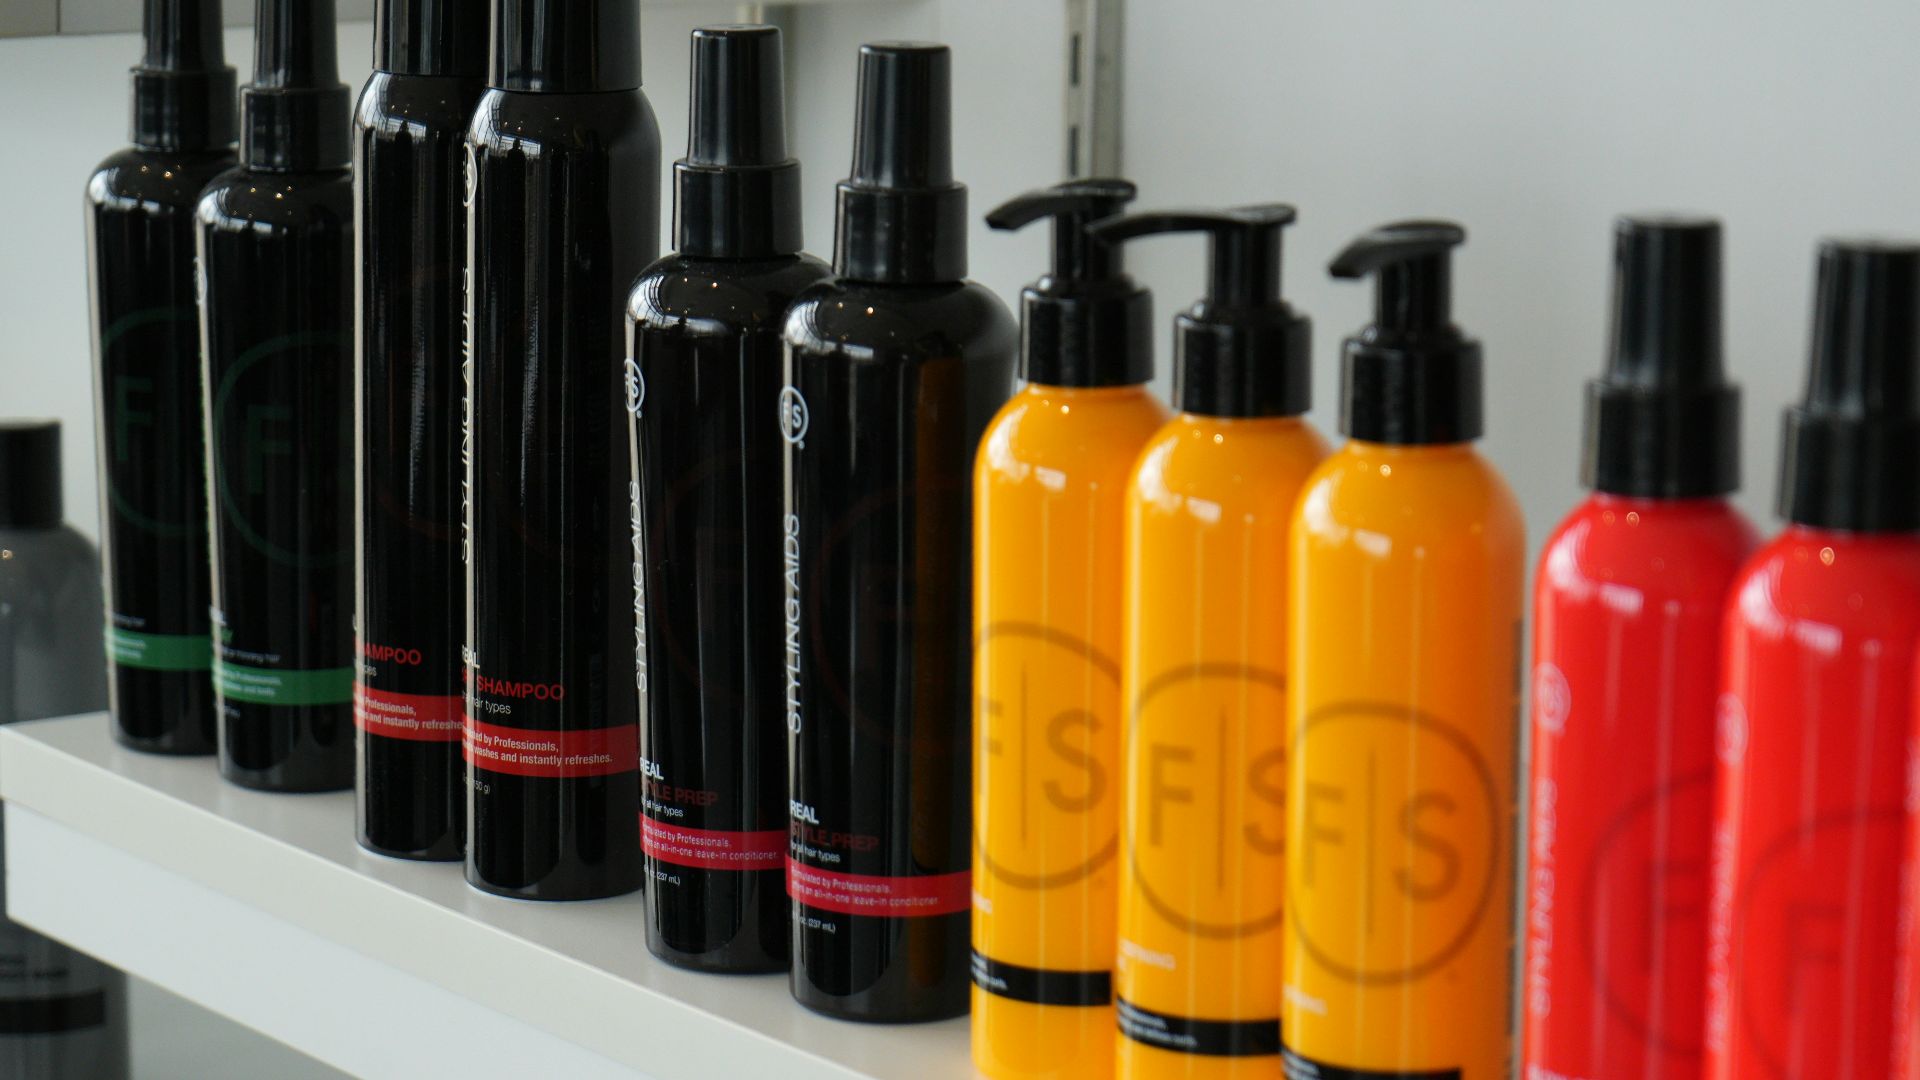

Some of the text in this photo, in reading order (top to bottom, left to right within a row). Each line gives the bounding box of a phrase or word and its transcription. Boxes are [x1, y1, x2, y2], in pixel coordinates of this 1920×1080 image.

[629, 481, 648, 692] STYLING AIDS
[783, 513, 801, 734] STYLING AIDS
[477, 674, 565, 701] SHAMPOO
[485, 700, 512, 715] types
[383, 714, 420, 731] instantly
[422, 719, 463, 731] refreshe
[483, 734, 493, 747] by
[494, 735, 559, 753] Professionals,
[501, 751, 517, 764] and
[519, 753, 562, 767] instantly
[565, 753, 613, 766] refreshes.
[640, 757, 664, 780] REAL
[663, 805, 684, 817] types
[789, 799, 819, 825] REAL
[667, 831, 676, 843] by
[661, 843, 693, 857] all-in-one
[818, 850, 841, 863] types
[822, 877, 831, 889] by
